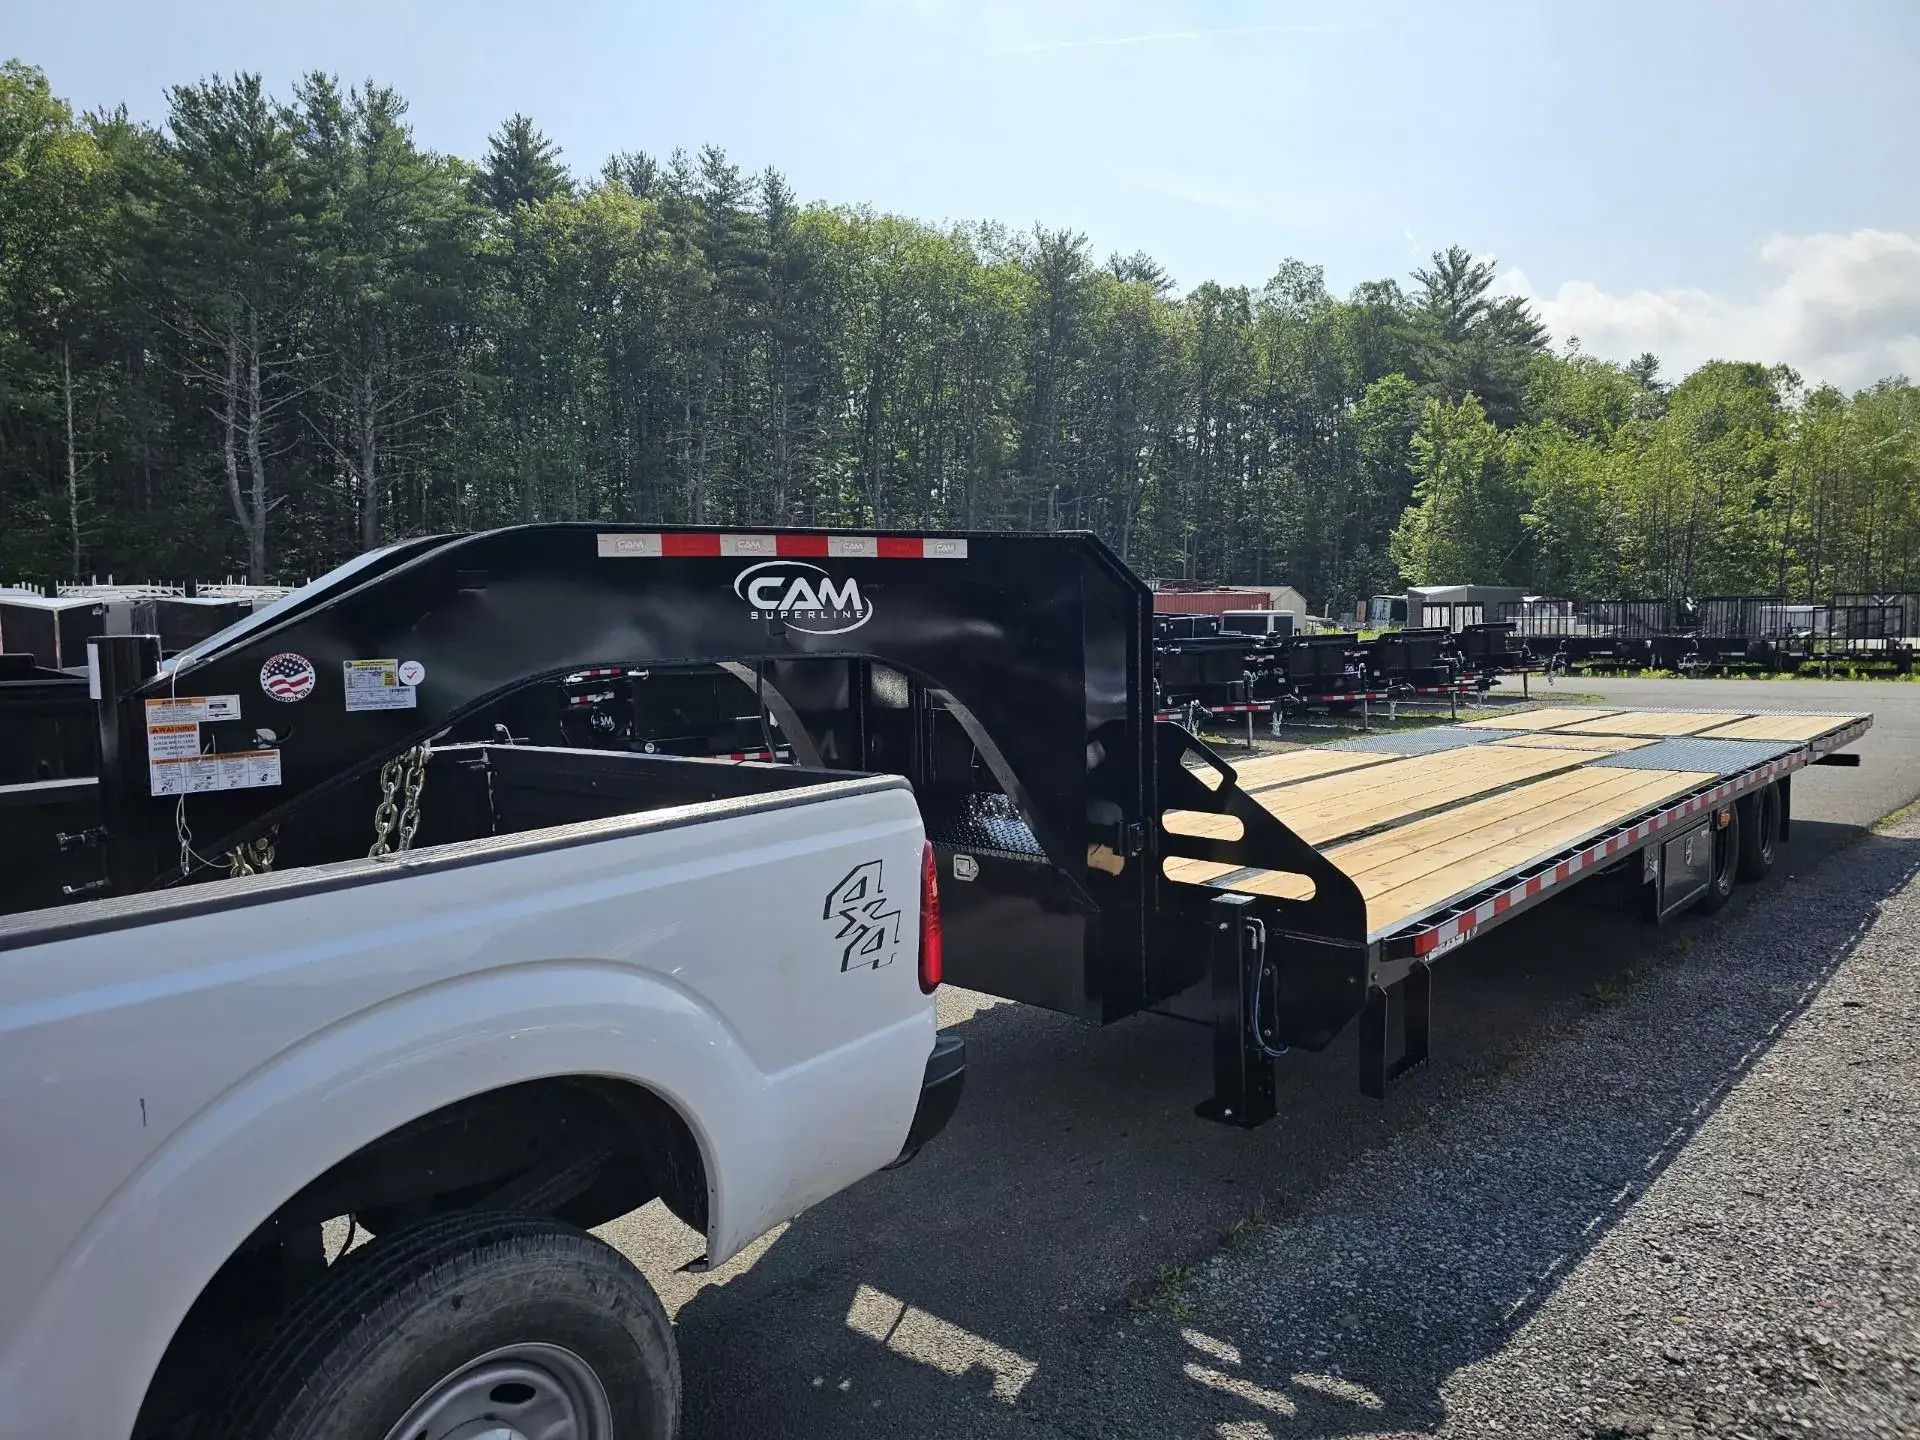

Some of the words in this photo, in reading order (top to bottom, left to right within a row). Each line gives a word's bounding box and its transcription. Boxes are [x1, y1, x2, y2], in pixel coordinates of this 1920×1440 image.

[842, 542, 863, 550] CAM
[936, 544, 955, 552] CAM
[748, 577, 863, 610] CAM
[750, 610, 864, 619] SUPERLINE
[263, 653, 286, 670] PROUDLY
[265, 687, 300, 701] MINNESOTA
[301, 687, 311, 697] USA
[159, 724, 196, 733] WARNING
